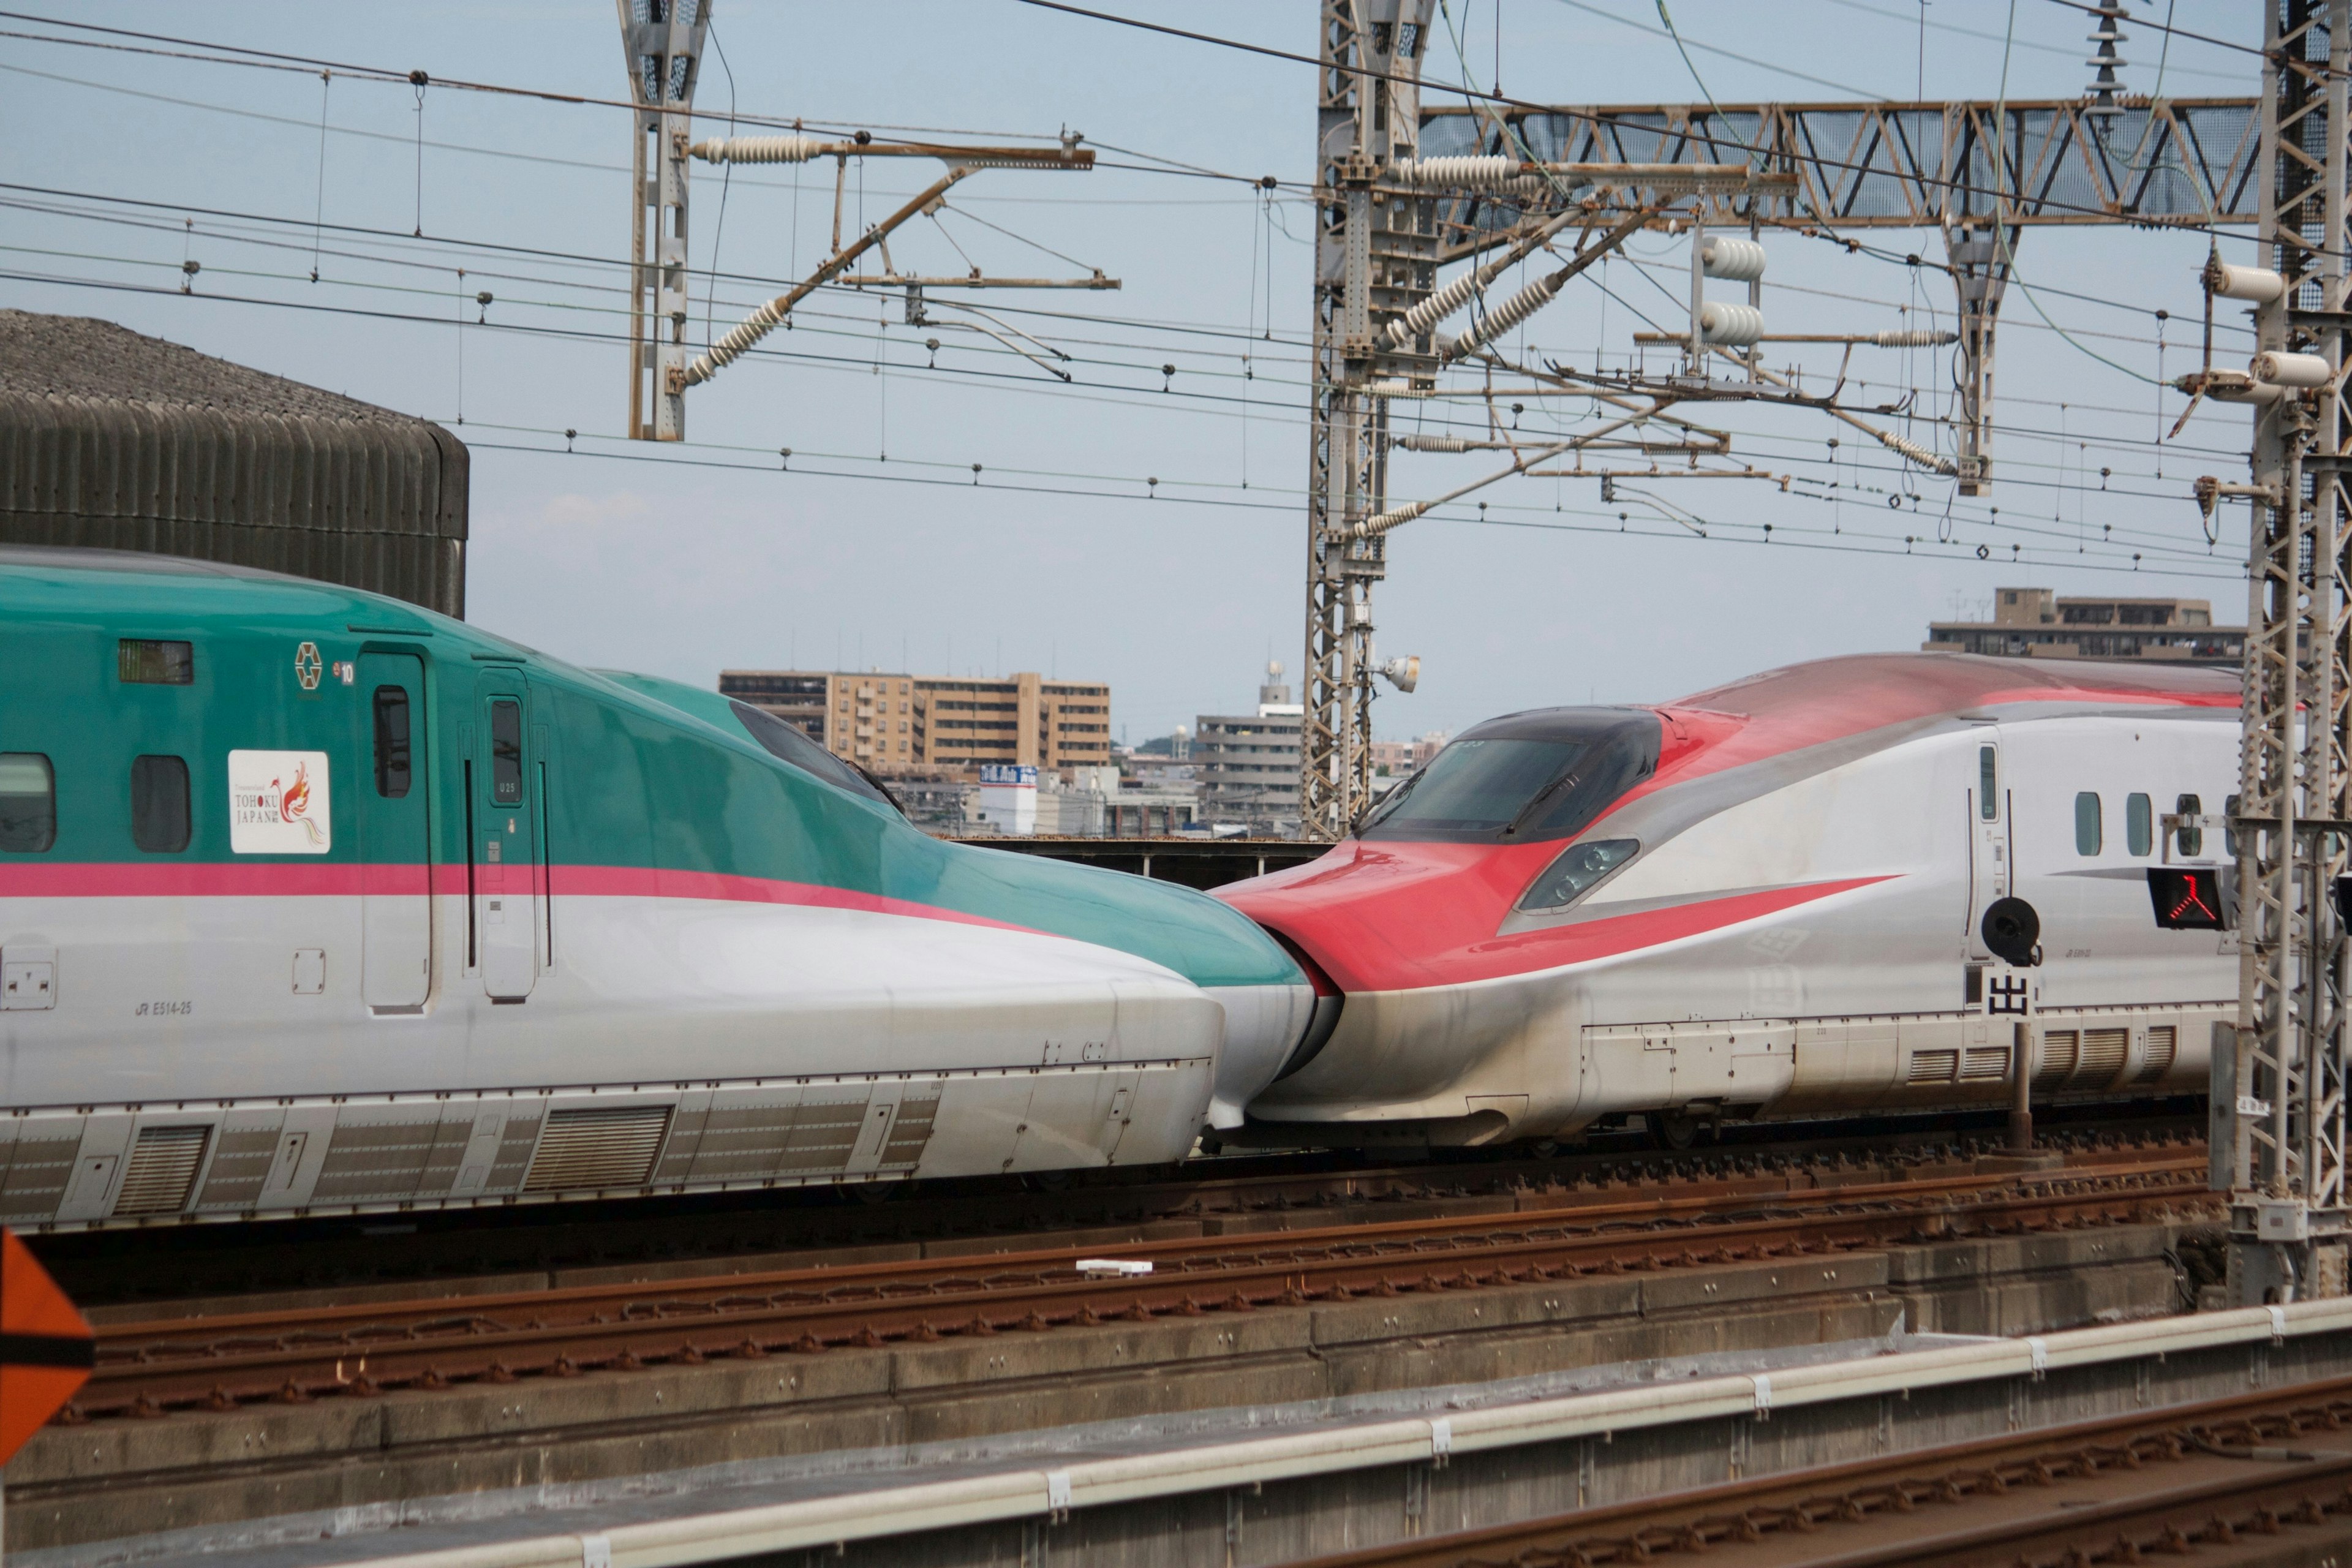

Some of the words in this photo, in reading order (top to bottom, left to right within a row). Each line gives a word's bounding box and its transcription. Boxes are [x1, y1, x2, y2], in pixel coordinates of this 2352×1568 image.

[342, 665, 353, 682] 10
[500, 783, 514, 793] U25
[235, 795, 278, 808] TOHOKU
[237, 810, 271, 825] JAPAN
[2202, 815, 2209, 827] 4
[1989, 975, 2027, 1016] 出
[135, 1003, 148, 1016] JR
[153, 1000, 192, 1015] E514-25
